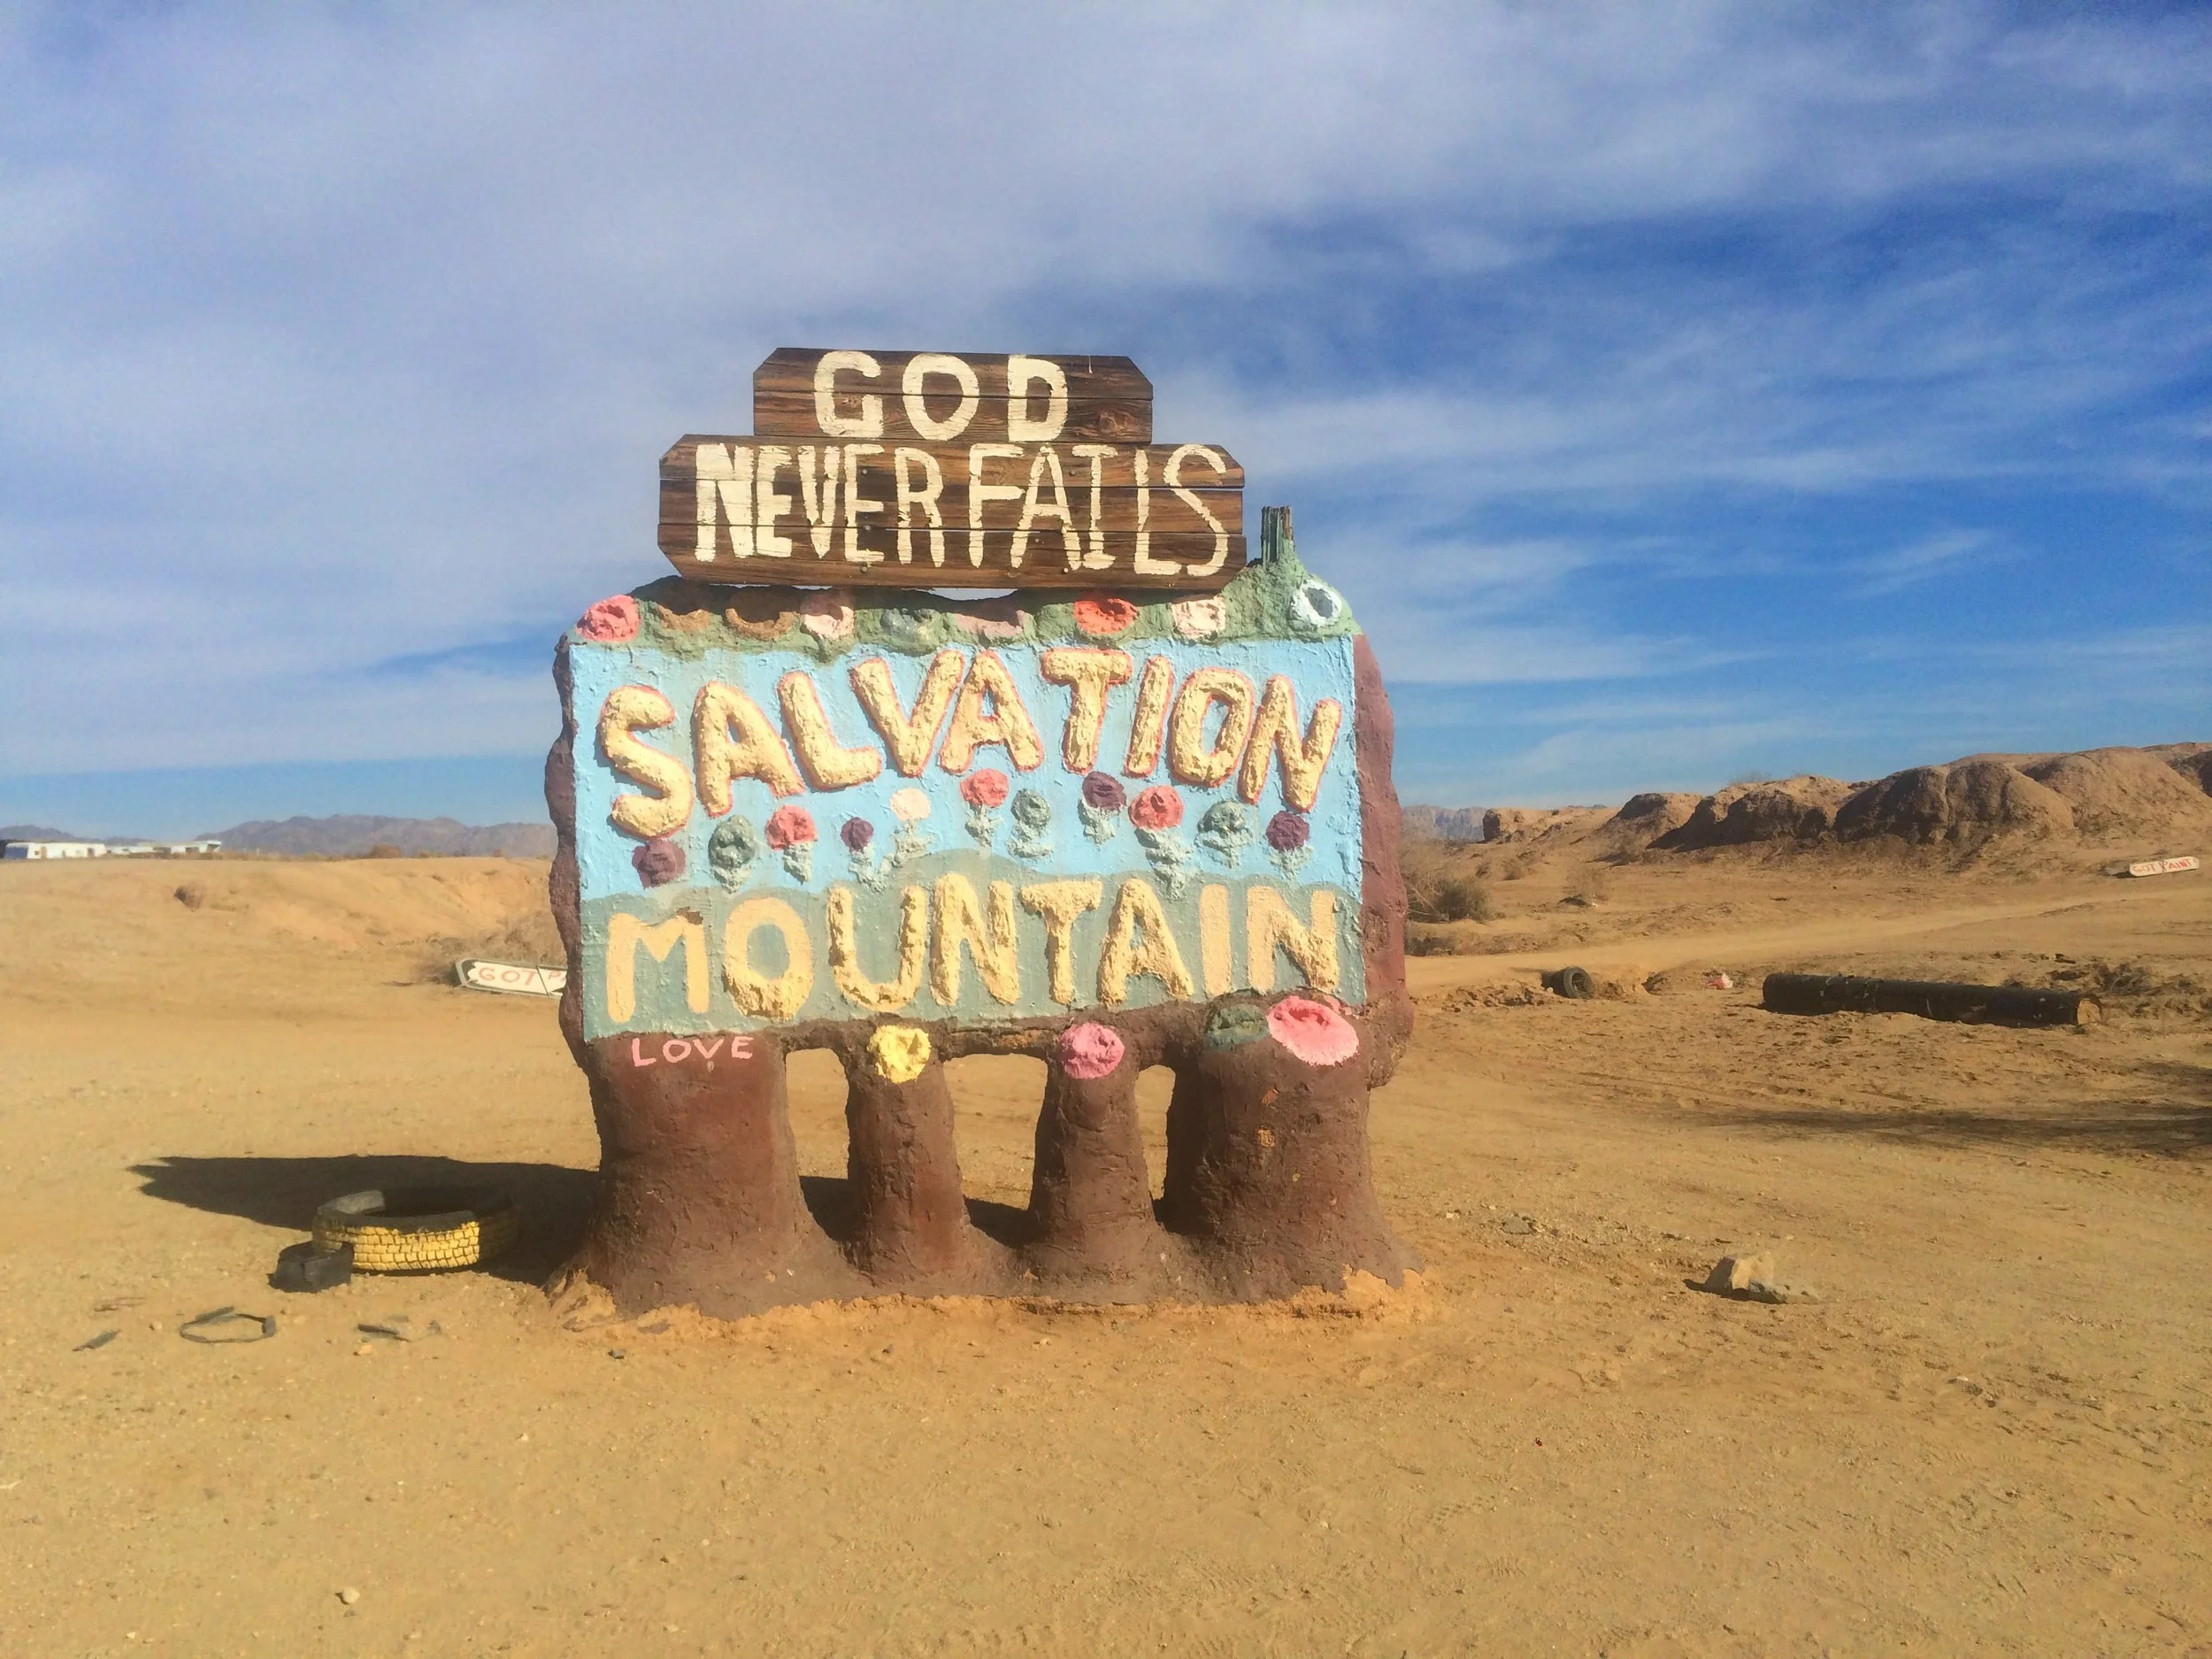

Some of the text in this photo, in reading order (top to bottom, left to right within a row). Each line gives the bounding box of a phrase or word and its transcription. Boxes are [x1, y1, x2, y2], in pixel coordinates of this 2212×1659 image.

[813, 350, 1068, 442] GOD
[695, 442, 1228, 577] NEVER FAILS
[599, 647, 1341, 840] SALVATION
[479, 967, 566, 986] GOT P
[607, 872, 1339, 1023] MOUNTAIN
[631, 1036, 755, 1067] LOVE
